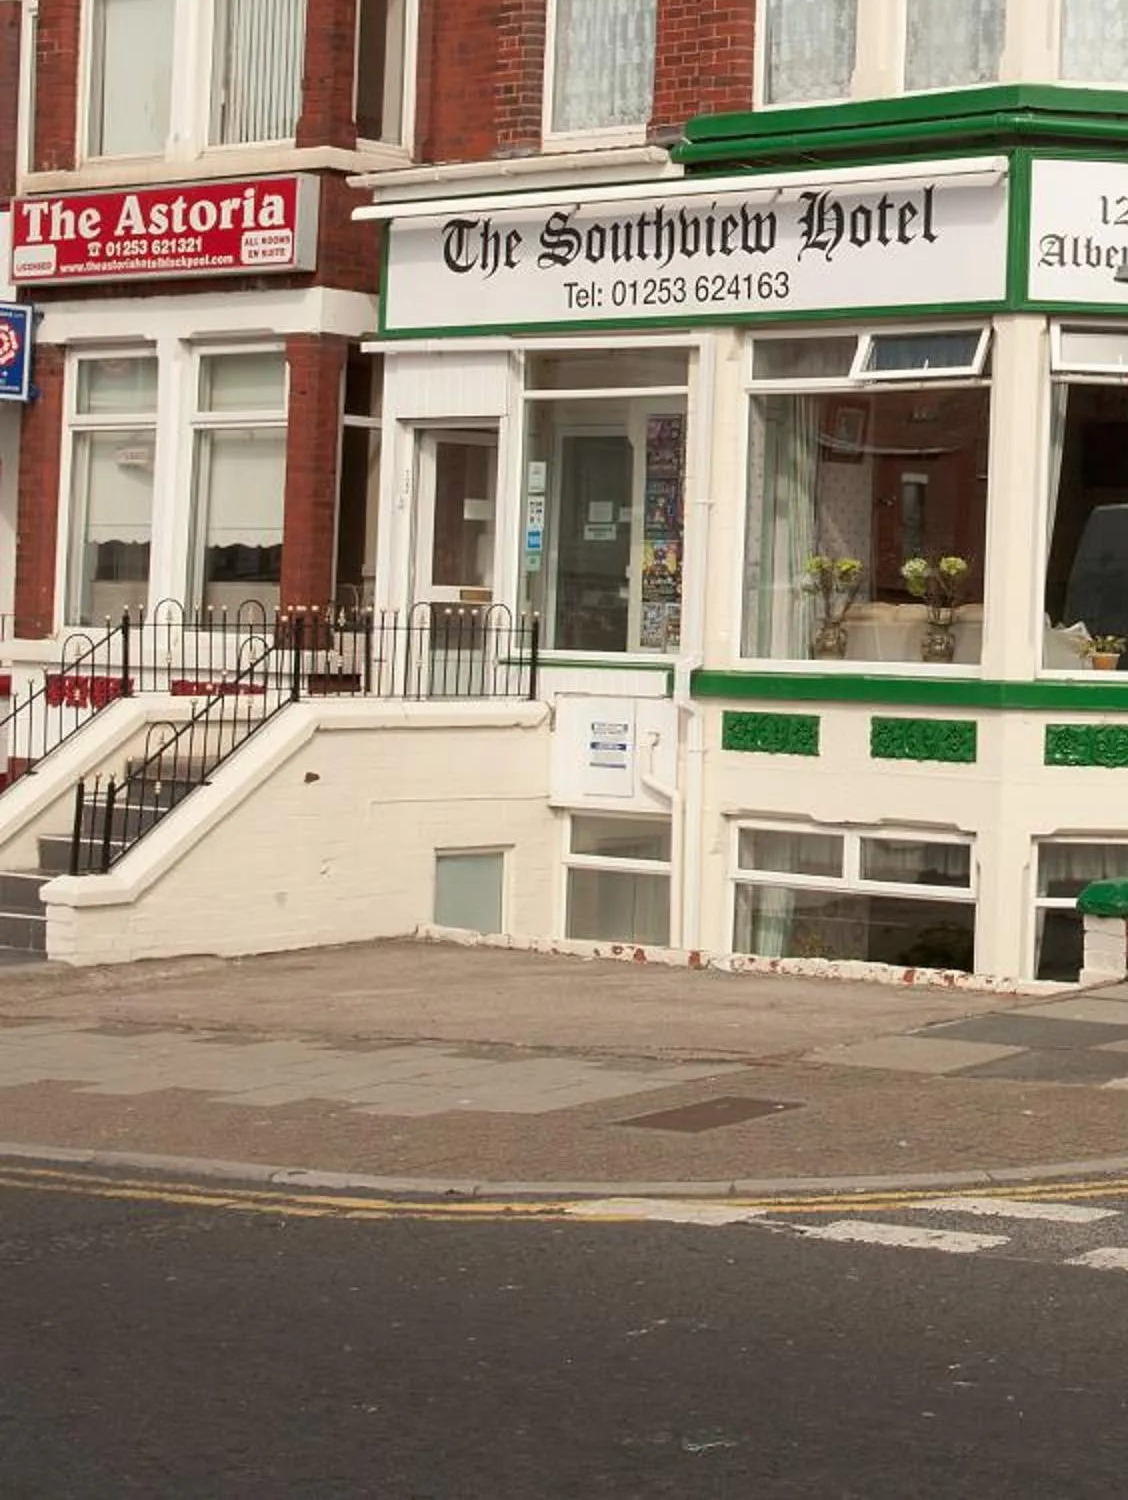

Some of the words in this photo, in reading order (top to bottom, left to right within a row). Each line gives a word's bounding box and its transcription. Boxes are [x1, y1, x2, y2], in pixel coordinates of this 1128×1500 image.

[22, 200, 101, 242] The
[114, 188, 285, 237] Astoria
[441, 217, 523, 280] The
[537, 201, 777, 270] Southview
[797, 185, 938, 263] Hotel
[105, 240, 148, 257] 01253
[151, 237, 203, 255] 621321
[563, 281, 603, 309] Tel:
[611, 277, 687, 307] 01253
[695, 271, 790, 304] 624163
